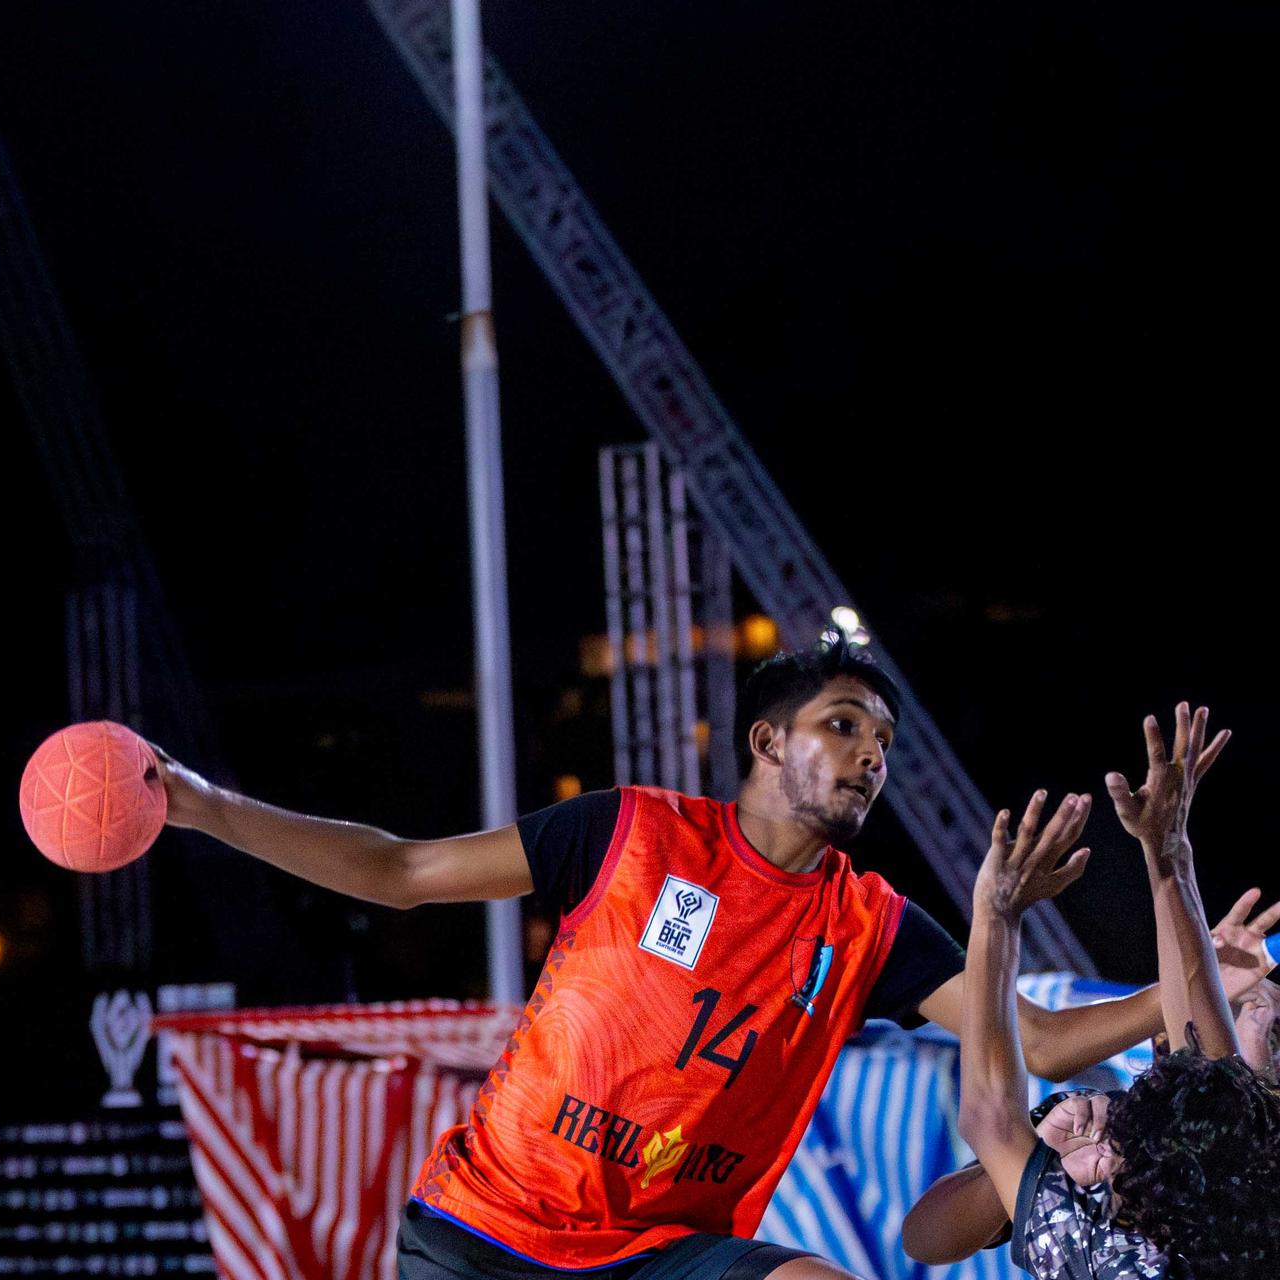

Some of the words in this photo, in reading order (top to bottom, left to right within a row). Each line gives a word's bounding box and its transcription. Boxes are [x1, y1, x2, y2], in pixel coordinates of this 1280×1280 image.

[657, 925, 691, 952] BHC
[674, 987, 759, 1090] 14
[551, 1093, 644, 1168] REAL
